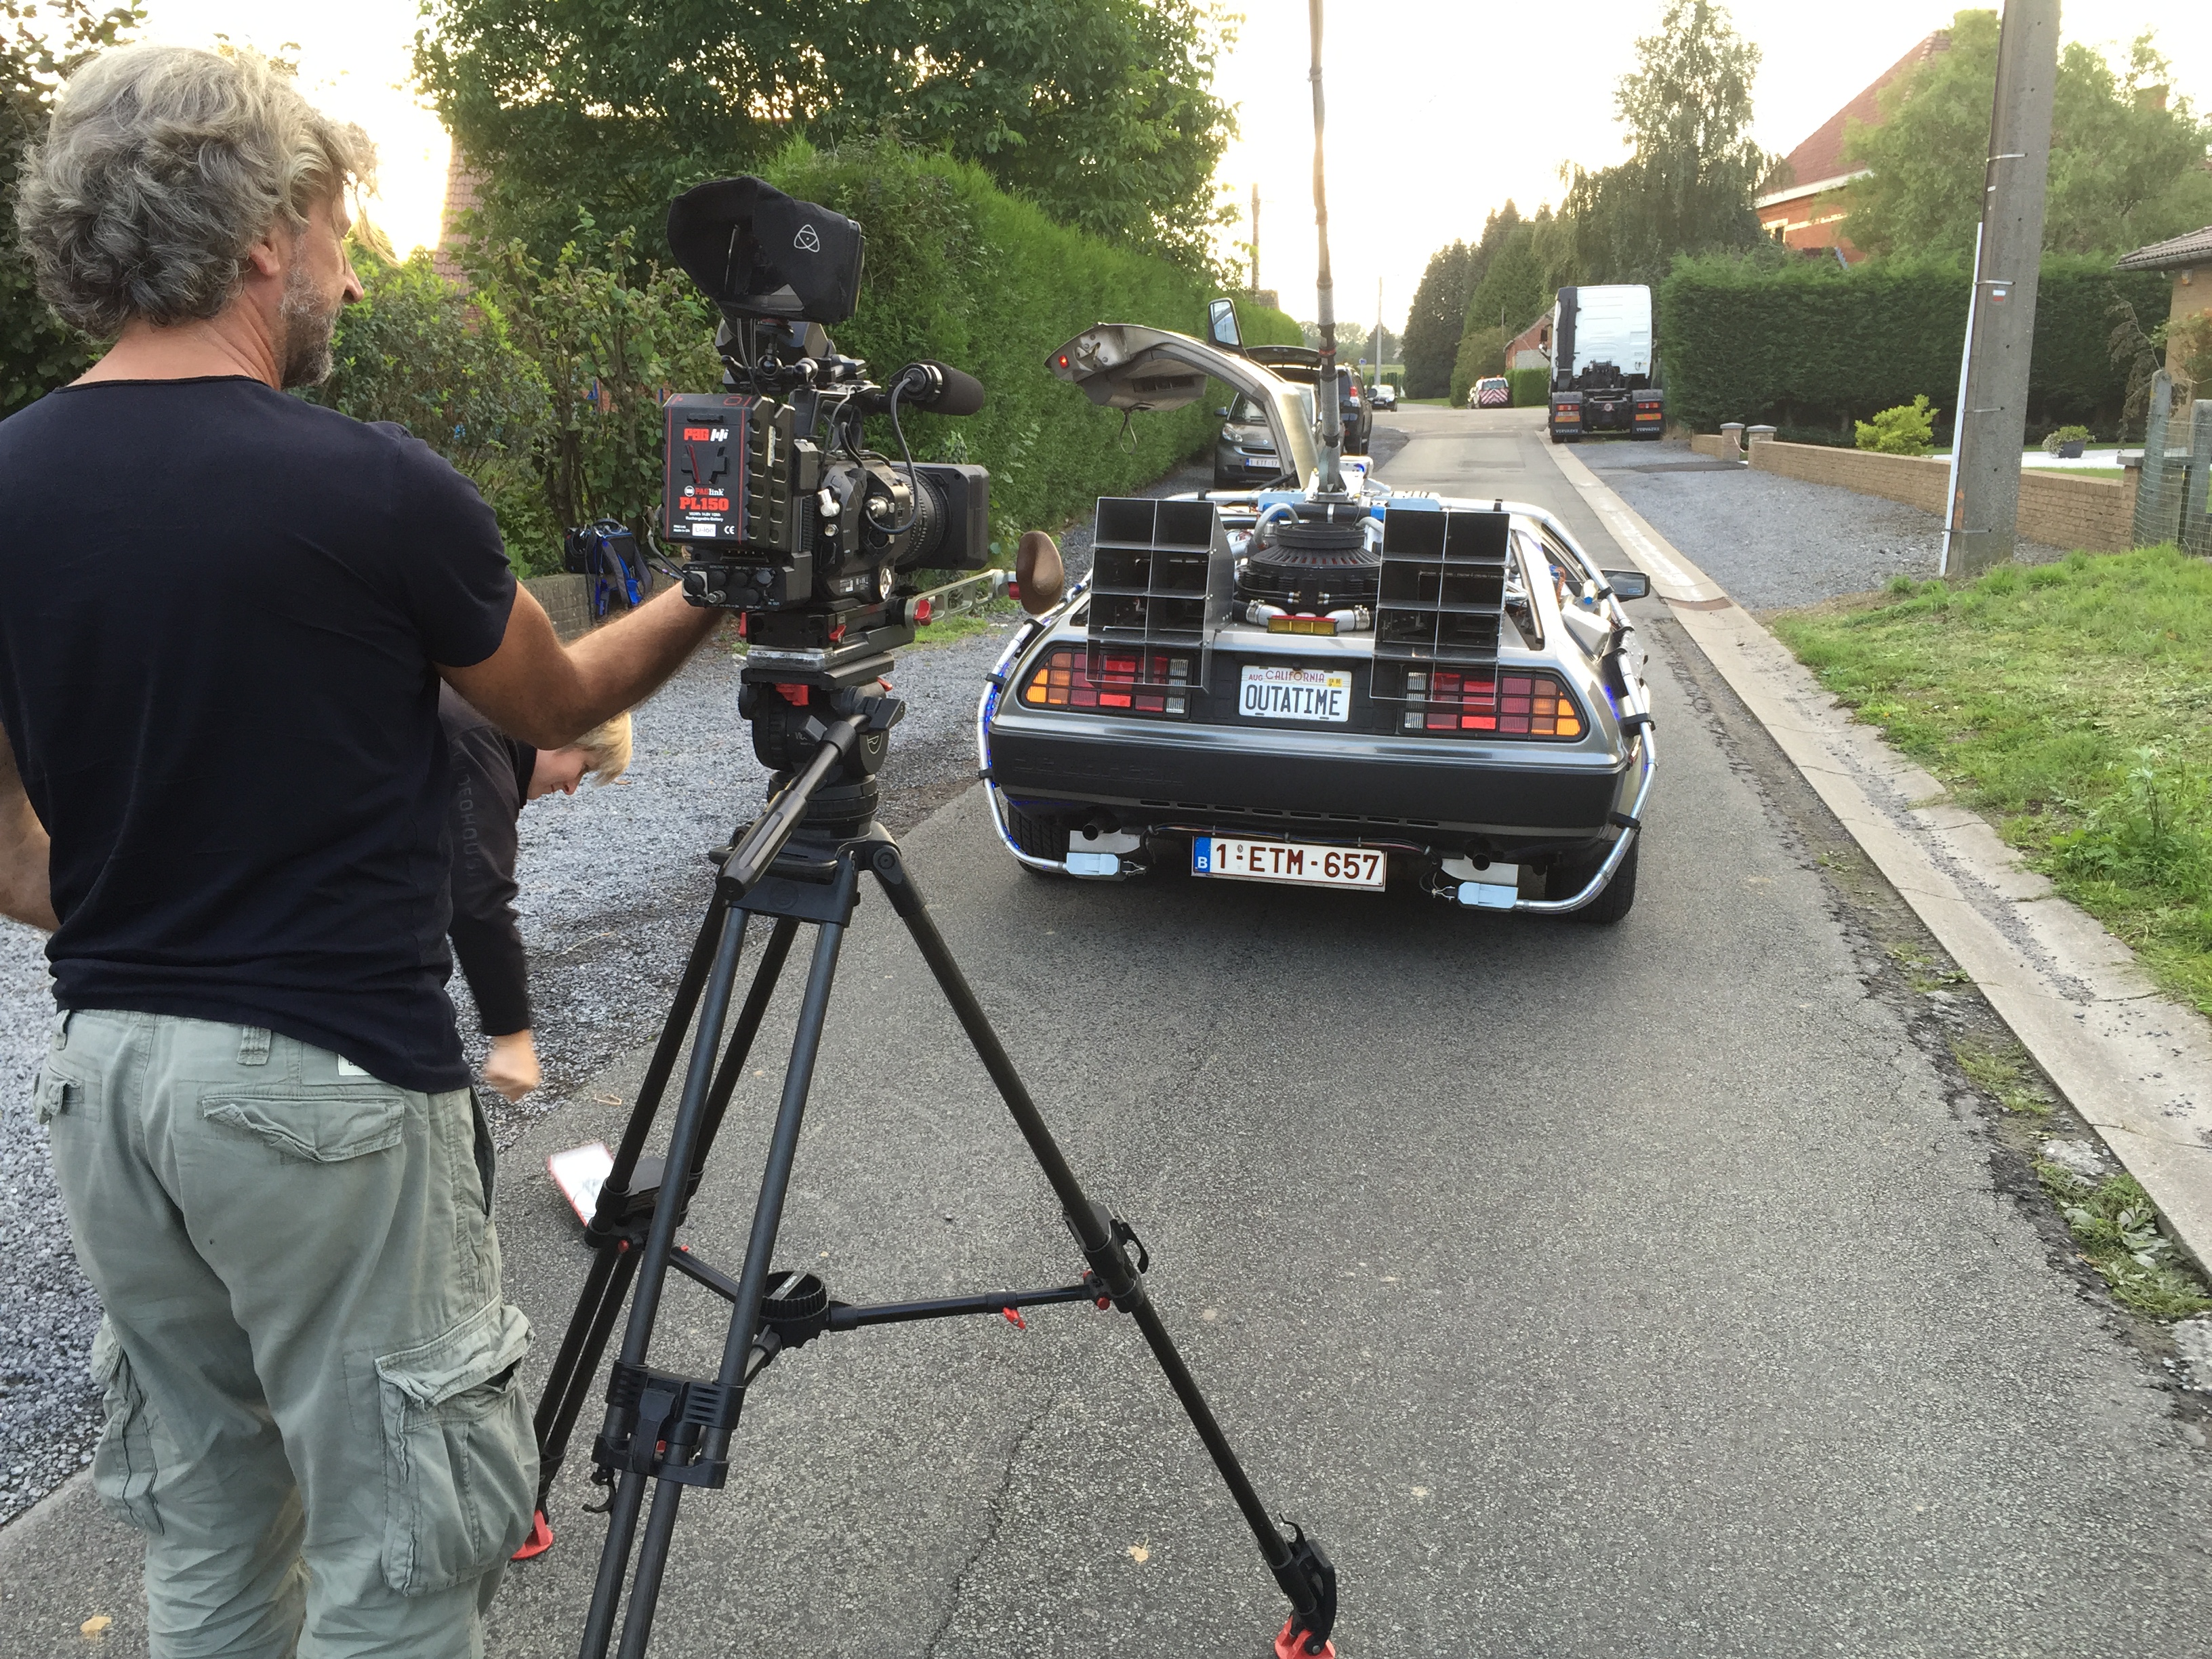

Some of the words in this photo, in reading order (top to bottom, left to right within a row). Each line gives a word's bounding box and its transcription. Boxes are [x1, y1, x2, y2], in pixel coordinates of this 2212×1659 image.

[684, 428, 710, 441] PAG
[679, 497, 729, 511] PL150
[1265, 670, 1325, 682] CALIFORNIA
[1246, 684, 1342, 716] OUTATIME
[1197, 857, 1208, 868] B
[1216, 844, 1379, 880] 1-ETM-657
